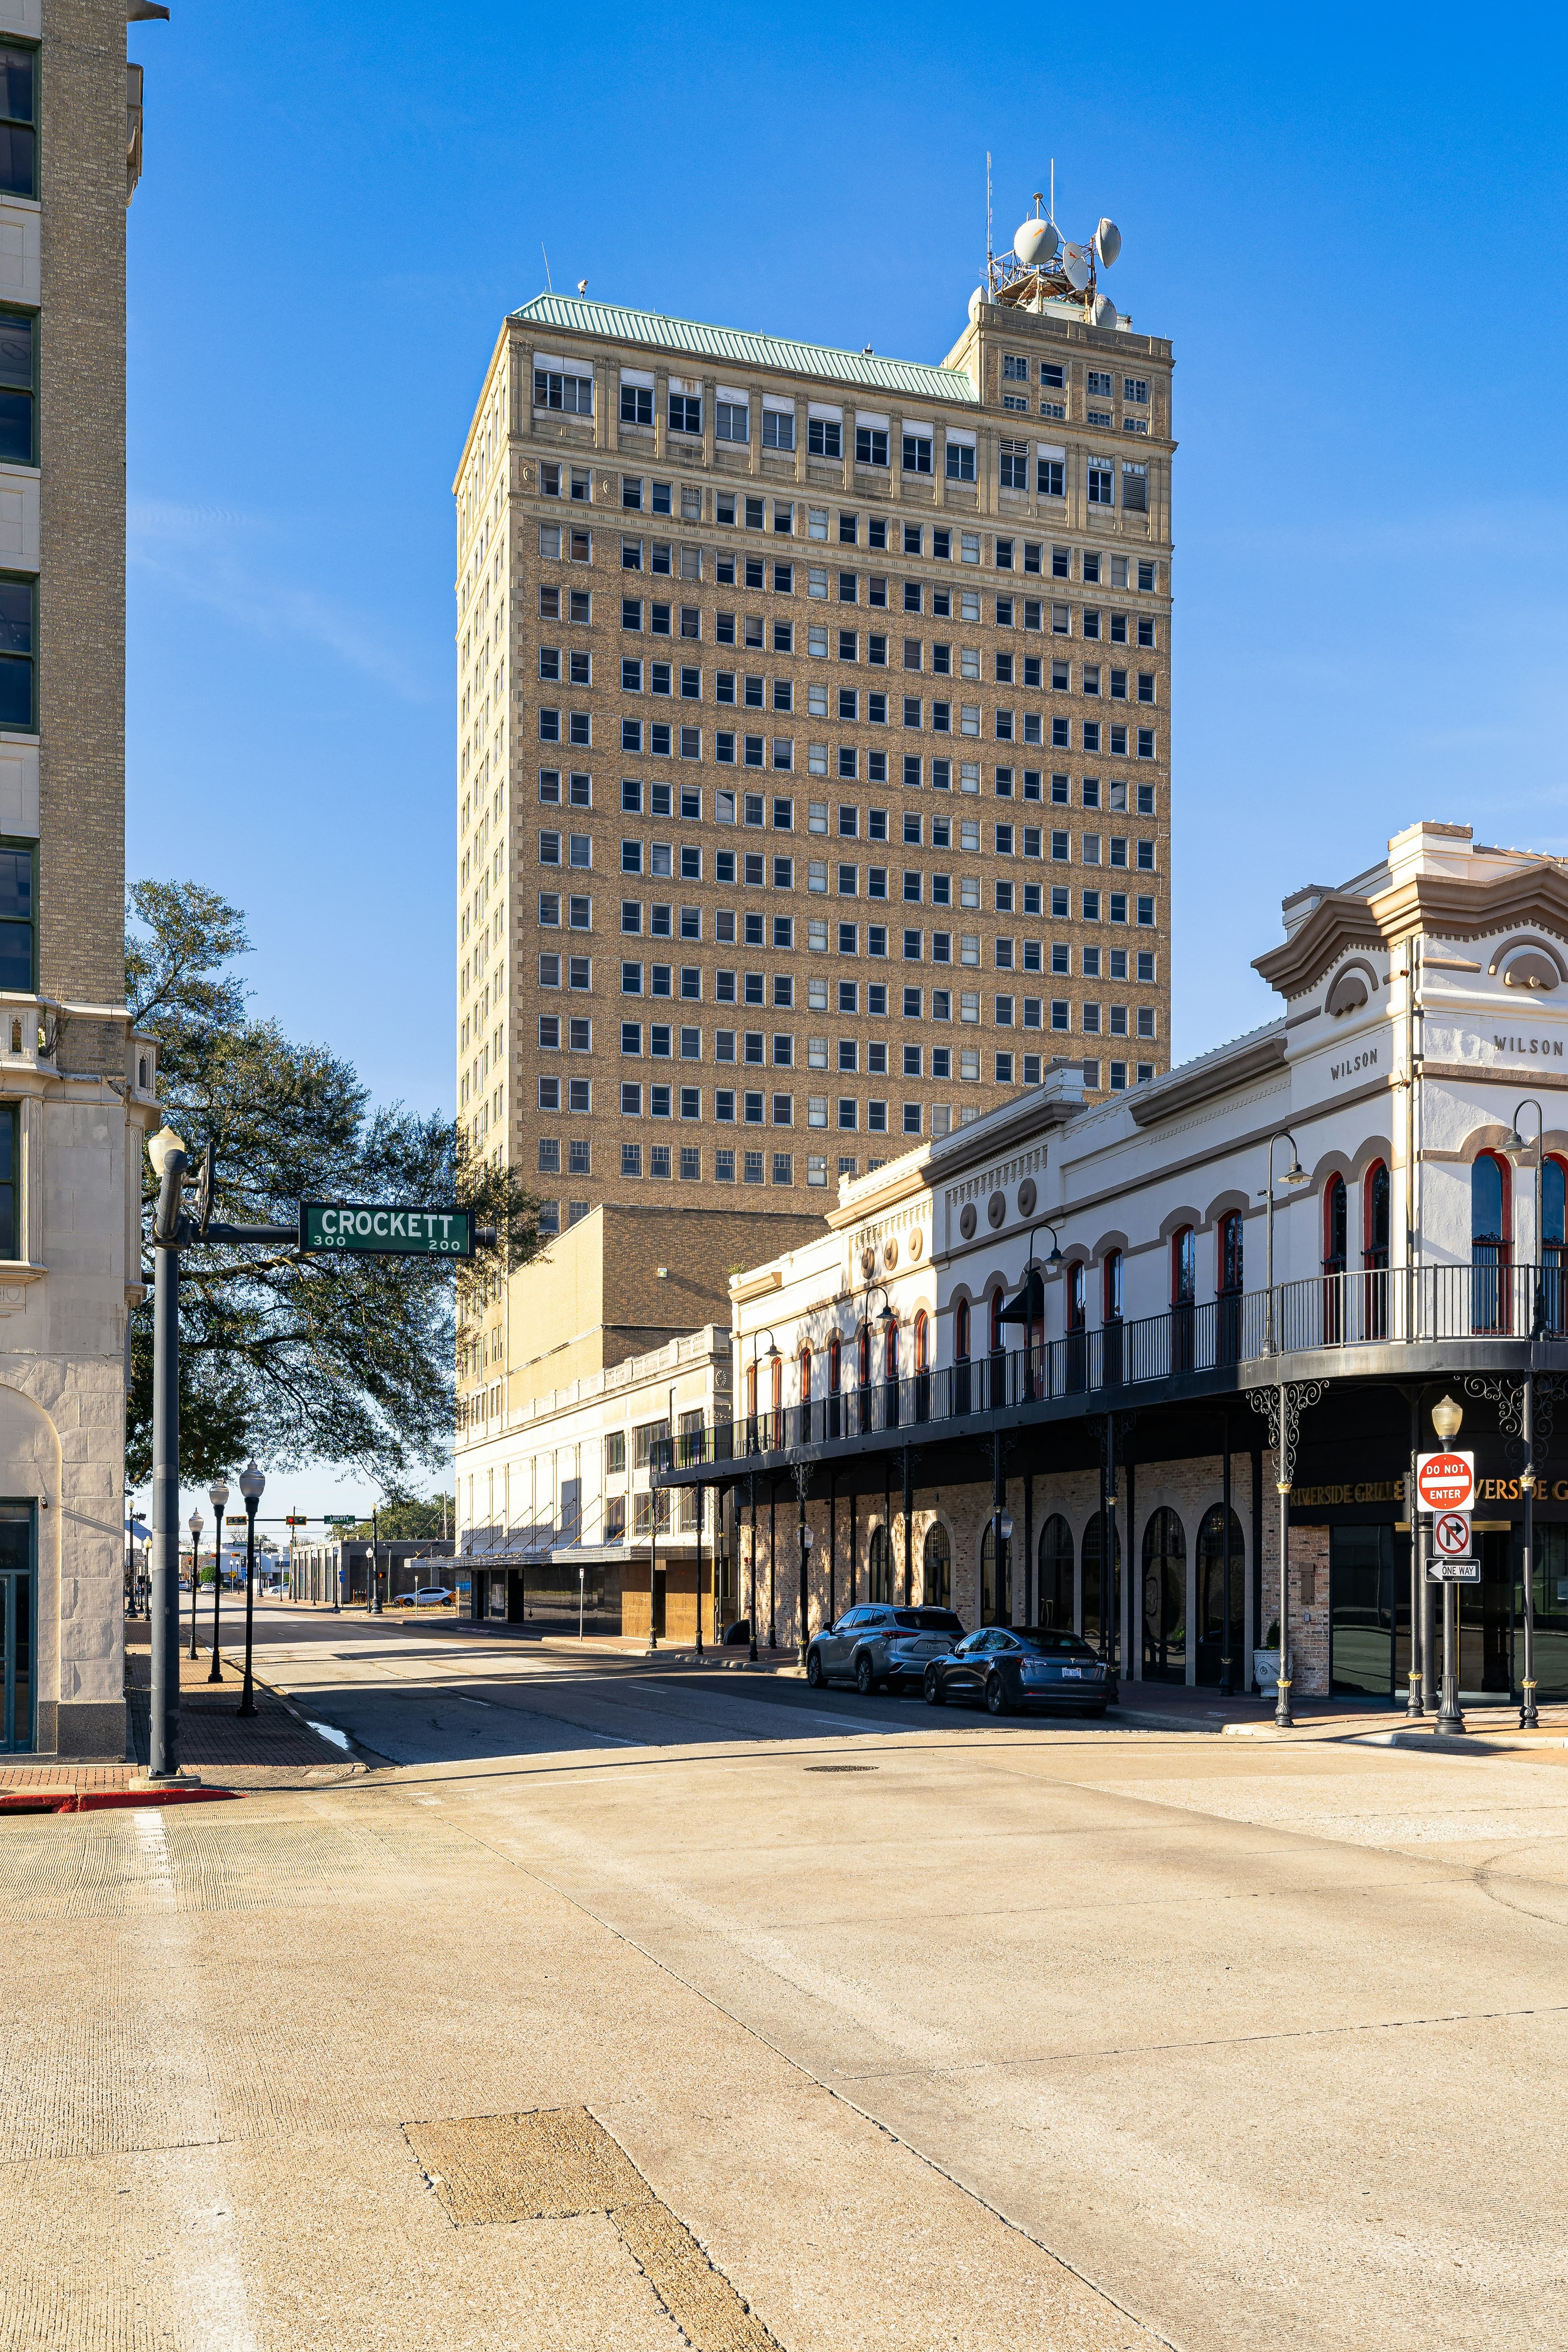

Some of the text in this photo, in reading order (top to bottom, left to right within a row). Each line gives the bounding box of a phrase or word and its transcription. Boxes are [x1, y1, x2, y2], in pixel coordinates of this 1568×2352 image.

[1494, 1035, 1563, 1056] WILSON
[1330, 1048, 1377, 1080] WILSON
[322, 1209, 453, 1238] CROCKETT
[313, 1236, 346, 1246] 300
[429, 1240, 460, 1251] 200
[1426, 1464, 1465, 1475] DO NOT
[1290, 1480, 1404, 1506] RIVERSIDE GRILLE
[1430, 1489, 1461, 1499] ENTER
[1442, 1566, 1474, 1575] ONE WAY
